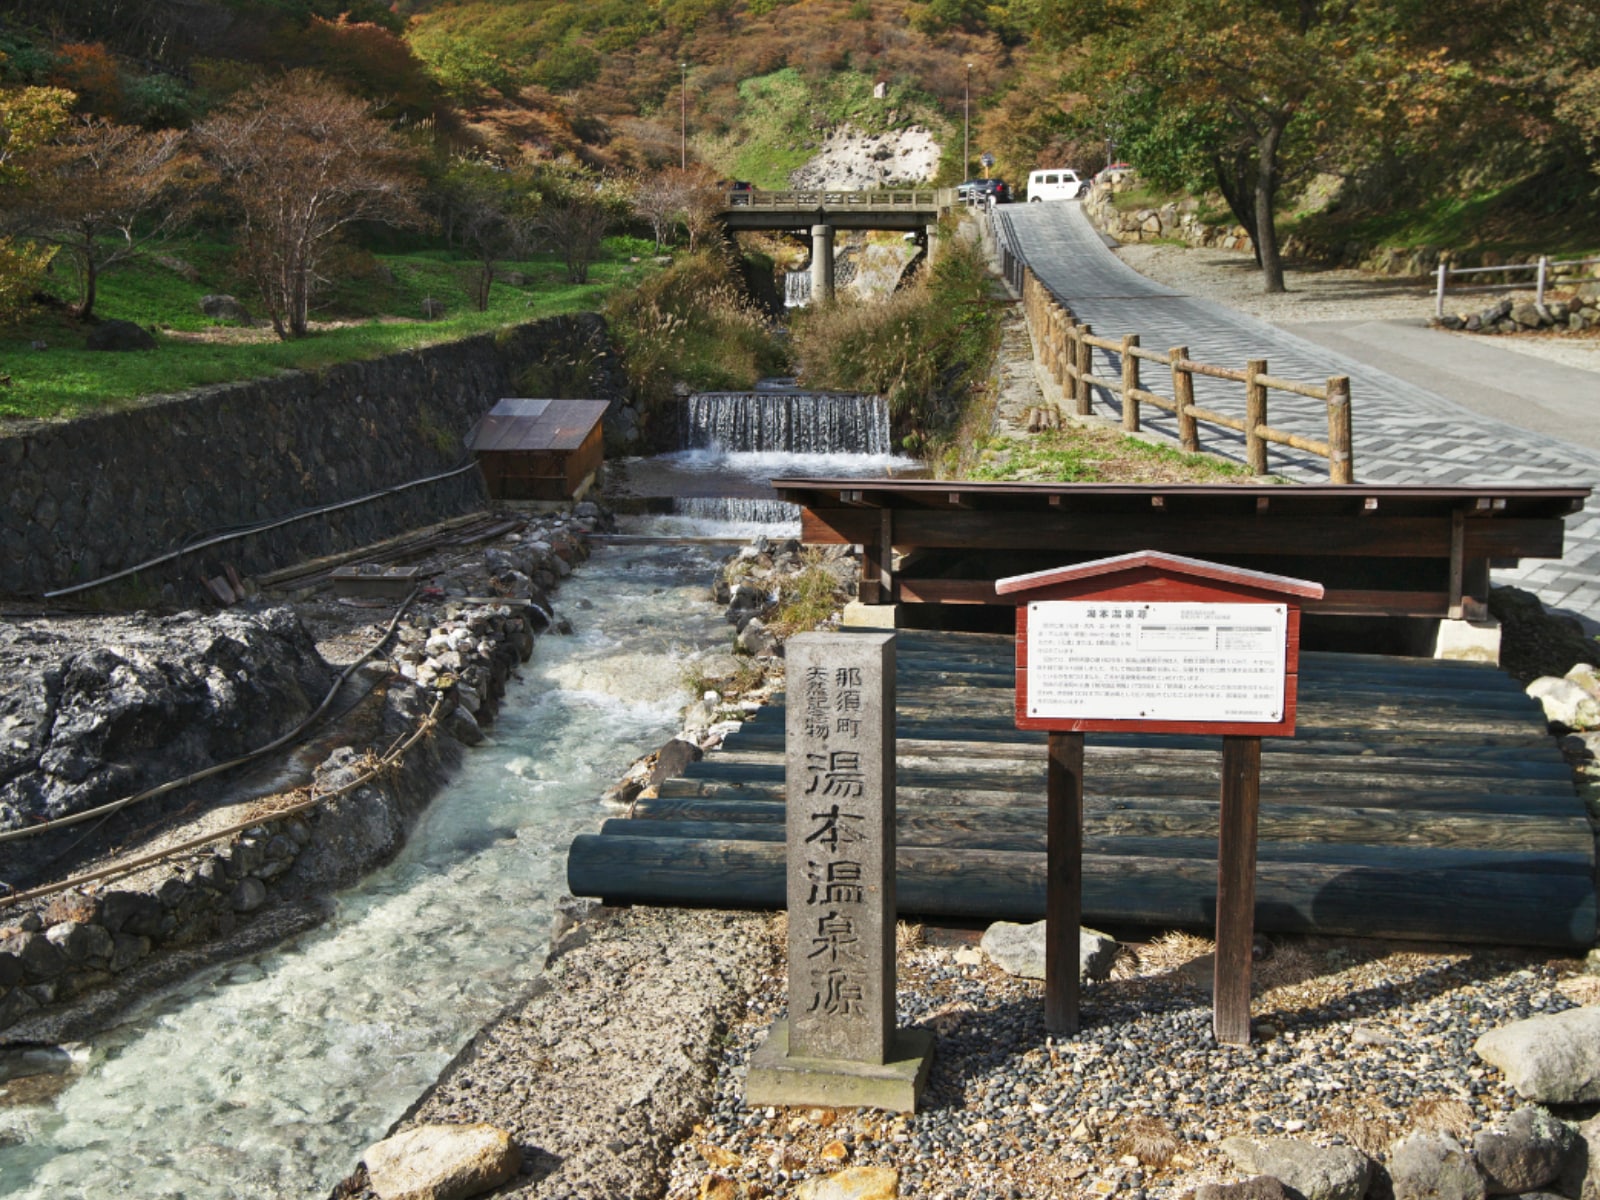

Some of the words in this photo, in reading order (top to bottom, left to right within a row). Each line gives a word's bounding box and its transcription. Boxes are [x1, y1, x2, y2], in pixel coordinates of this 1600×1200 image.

[805, 666, 830, 739] 天然記念物
[836, 667, 863, 738] 那須町
[805, 750, 870, 1015] 湯本温泉源
